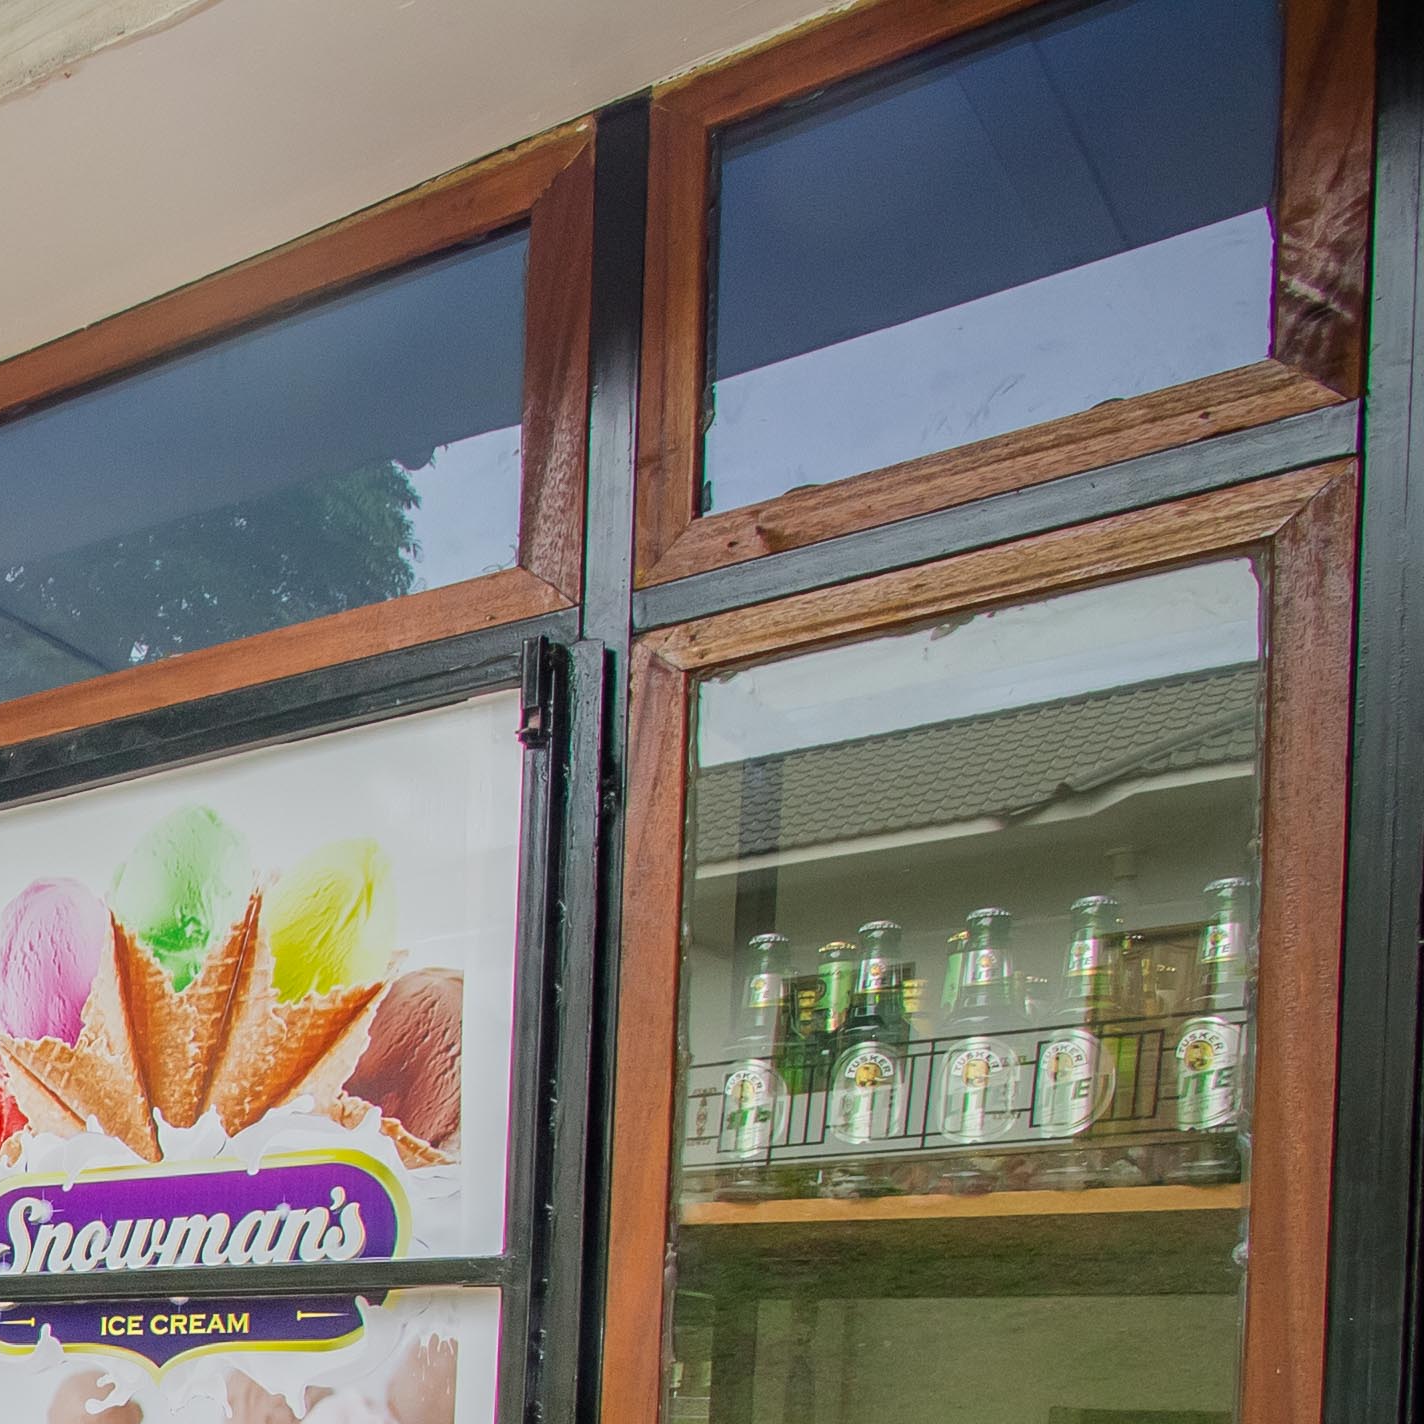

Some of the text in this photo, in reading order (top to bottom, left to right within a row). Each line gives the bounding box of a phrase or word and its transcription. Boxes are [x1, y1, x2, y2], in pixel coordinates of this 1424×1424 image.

[1178, 1031, 1225, 1053] TUSKER
[848, 1054, 893, 1075] TUSKER
[955, 1051, 1001, 1073] TUSKER
[1041, 1044, 1084, 1068] TUSKER
[727, 1072, 765, 1094] TUSKER
[100, 1313, 249, 1335] ICE CREAM
